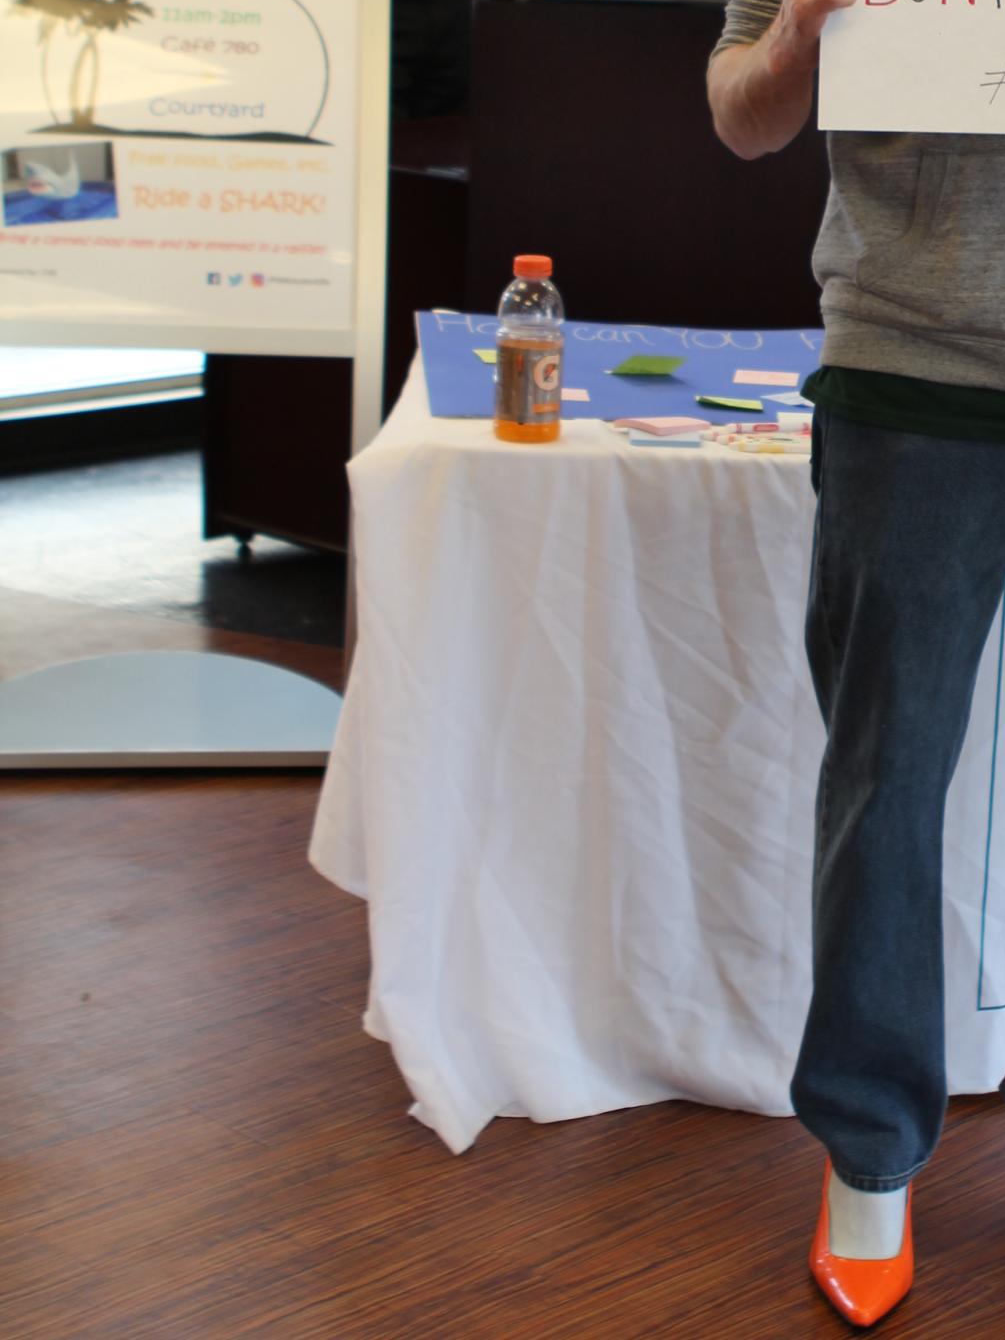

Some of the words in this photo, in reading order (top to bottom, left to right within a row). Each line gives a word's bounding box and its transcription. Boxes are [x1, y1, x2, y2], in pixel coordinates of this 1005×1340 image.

[221, 39, 260, 55] 780
[148, 97, 265, 119] Courtyard
[132, 184, 192, 210] Ride
[199, 191, 213, 209] a
[219, 189, 327, 215] SHARK!
[573, 326, 655, 347] can
[533, 354, 560, 391] G
